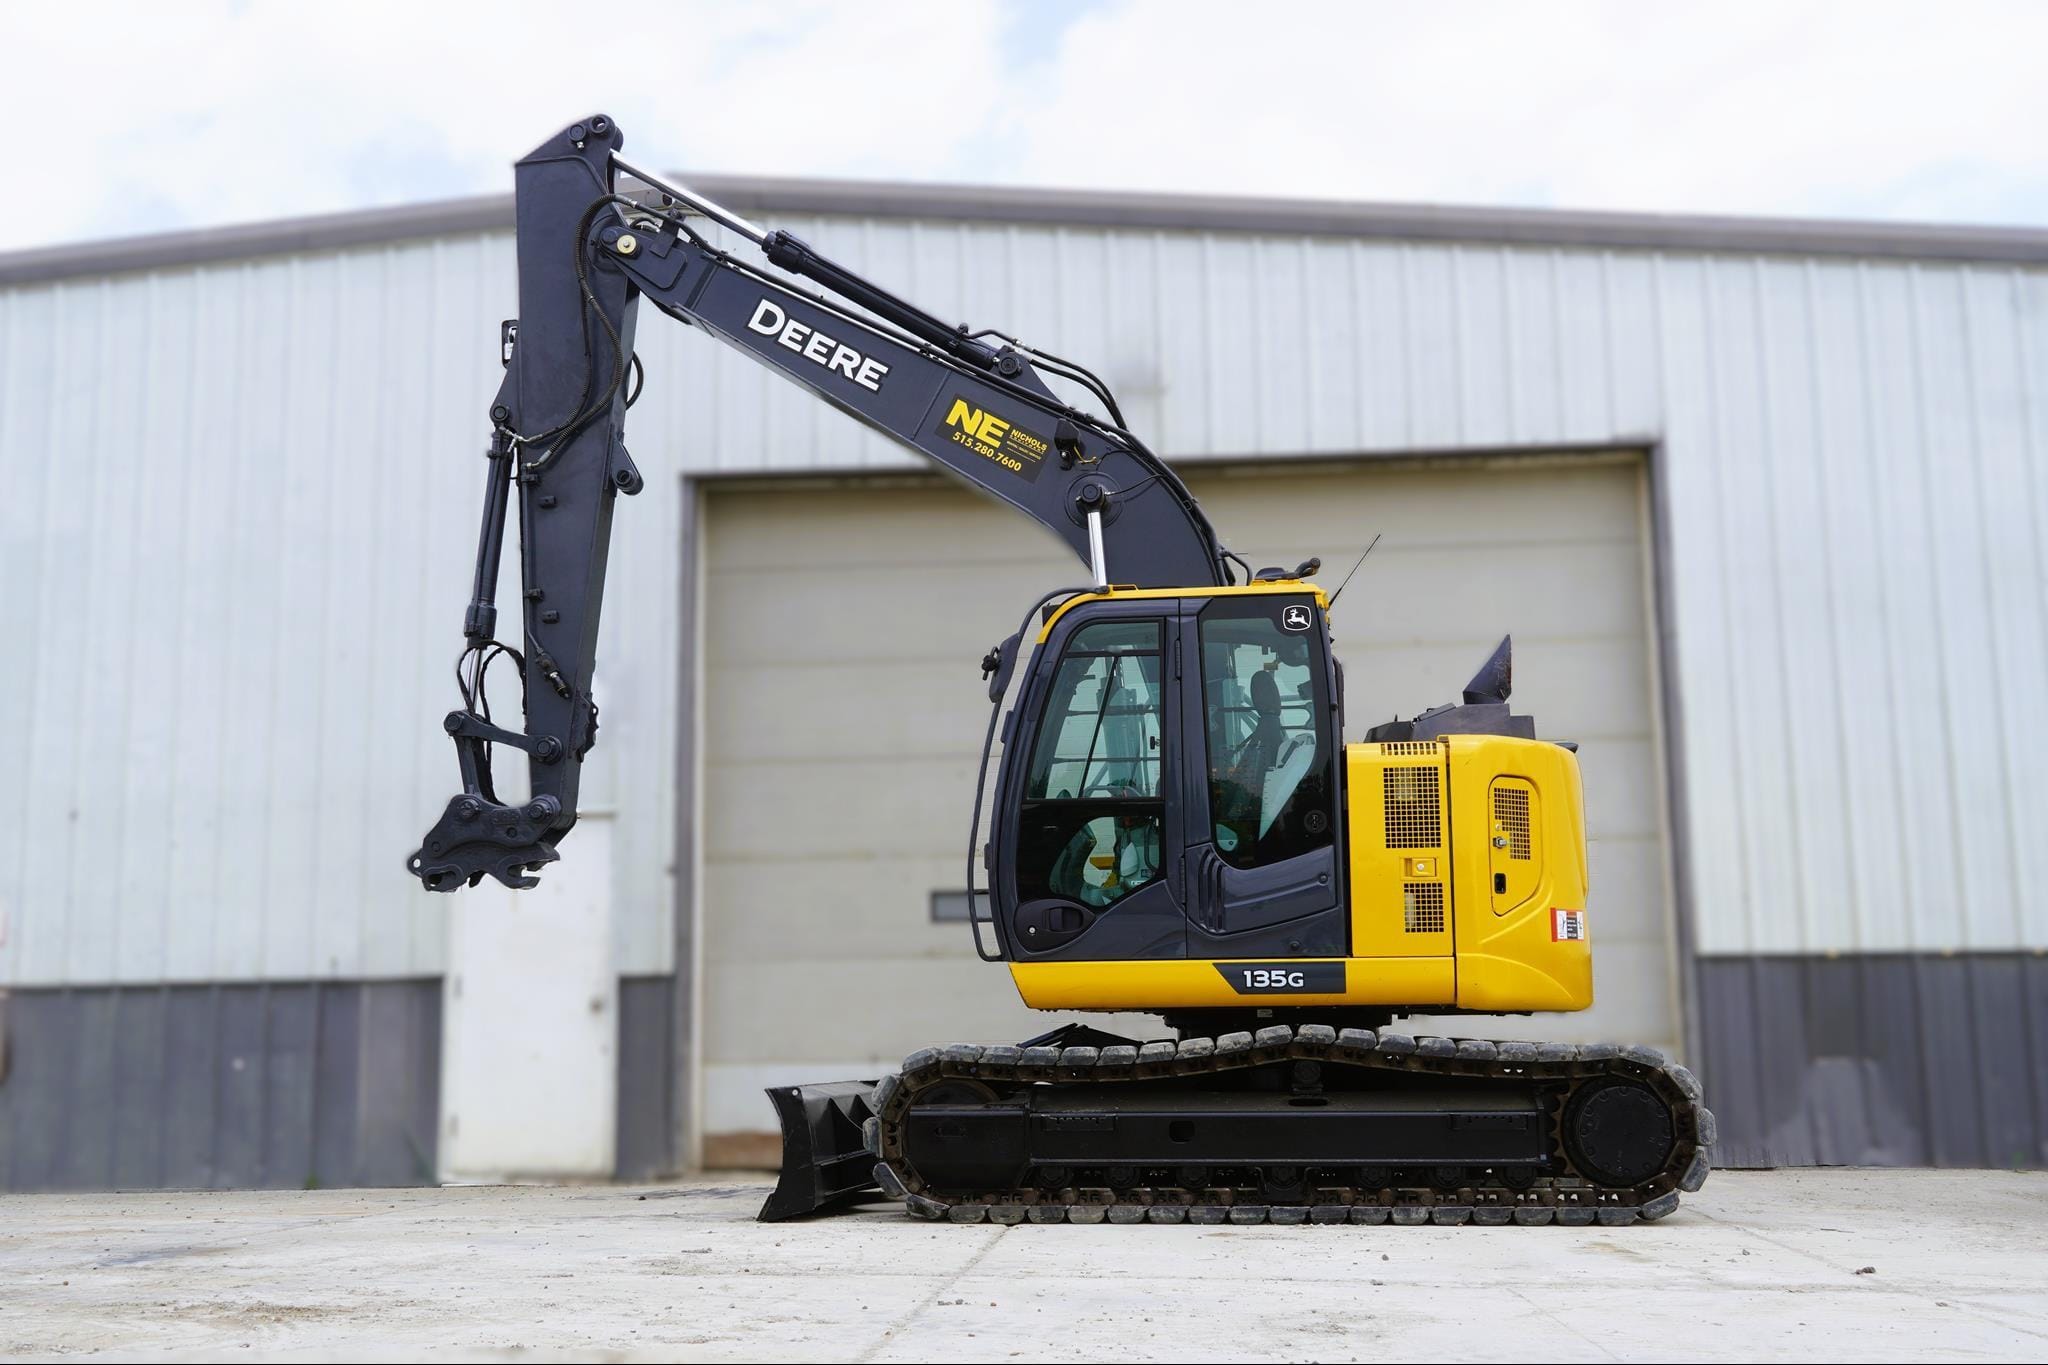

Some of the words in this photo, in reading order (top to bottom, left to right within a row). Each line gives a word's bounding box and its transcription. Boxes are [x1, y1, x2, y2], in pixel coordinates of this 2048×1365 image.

[748, 299, 889, 391] DEERE
[945, 399, 1011, 449] NE
[1010, 428, 1048, 451] NICHOLS
[952, 431, 1022, 472] 515.280.7600
[1243, 970, 1304, 988] 135G
